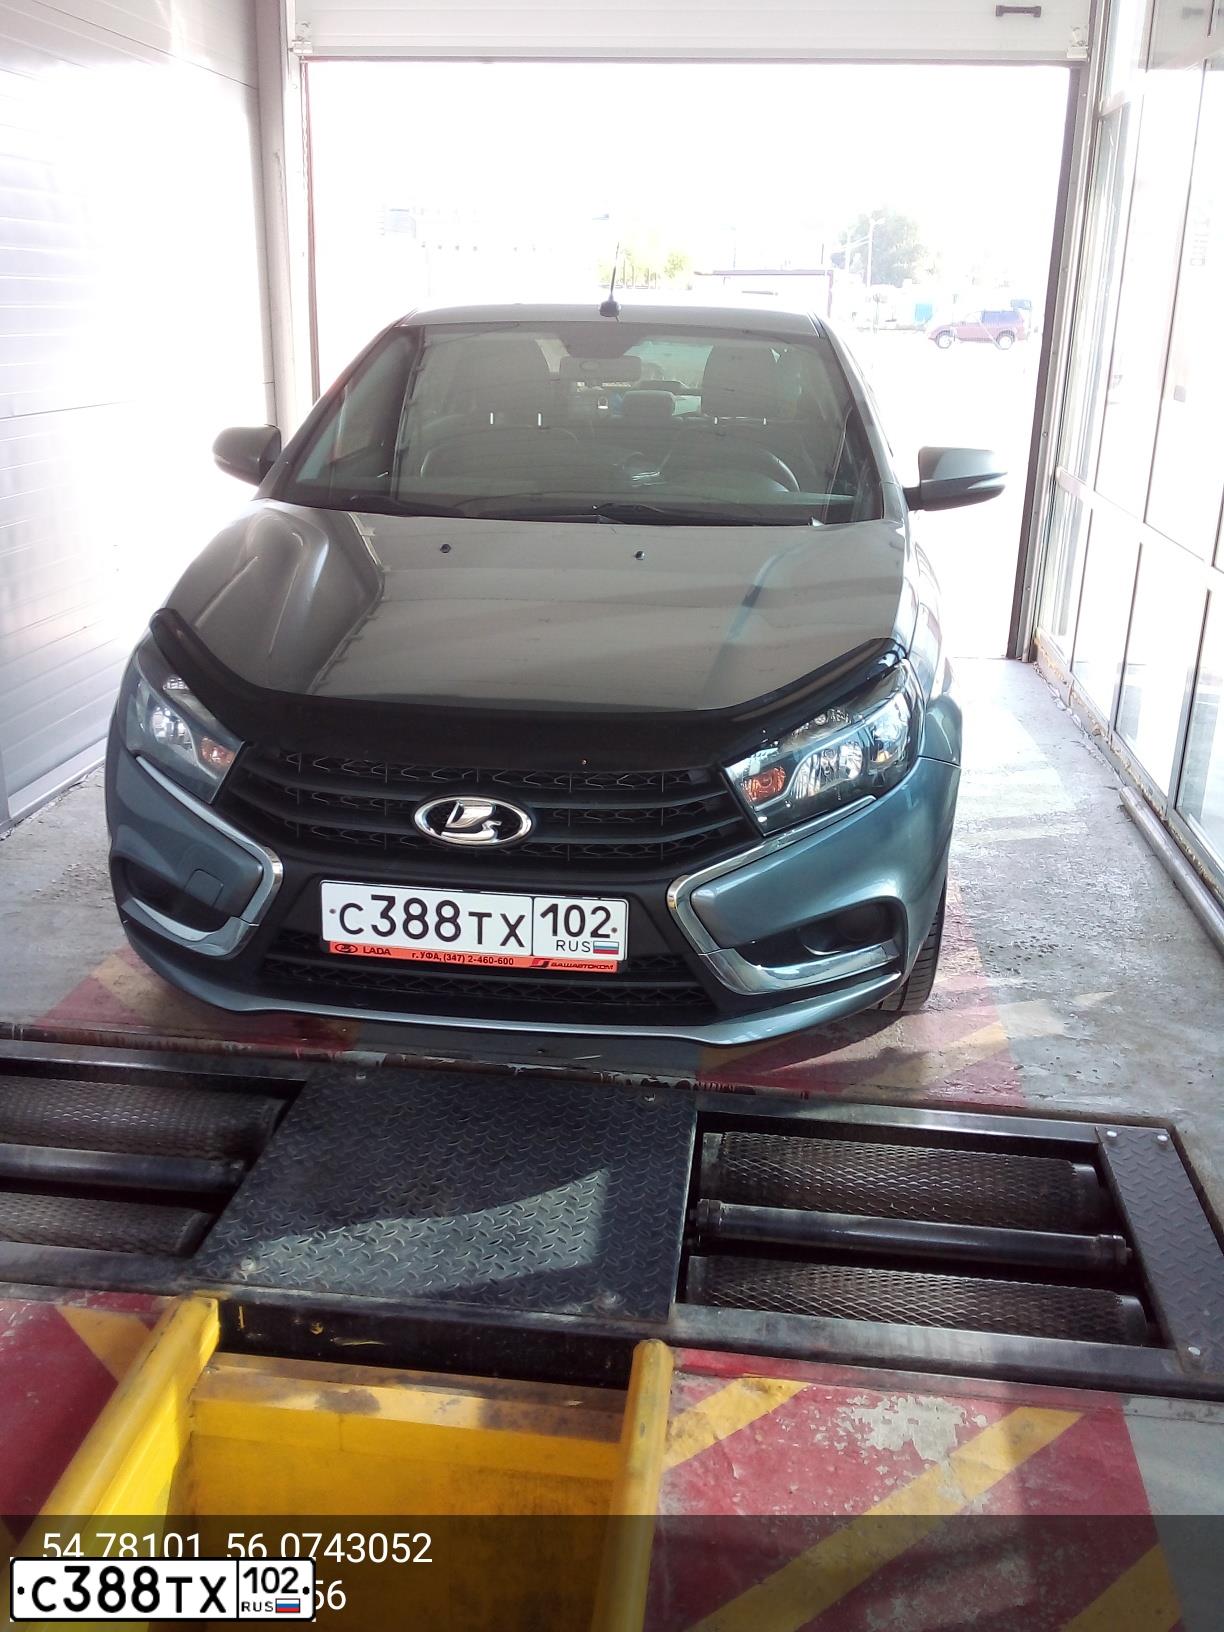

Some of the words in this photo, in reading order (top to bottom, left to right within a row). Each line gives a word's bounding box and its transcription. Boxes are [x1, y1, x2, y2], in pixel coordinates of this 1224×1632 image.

[339, 894, 526, 948] С388ТХ
[540, 903, 611, 939] 102
[363, 946, 391, 956] LADA
[556, 940, 591, 953] RUS
